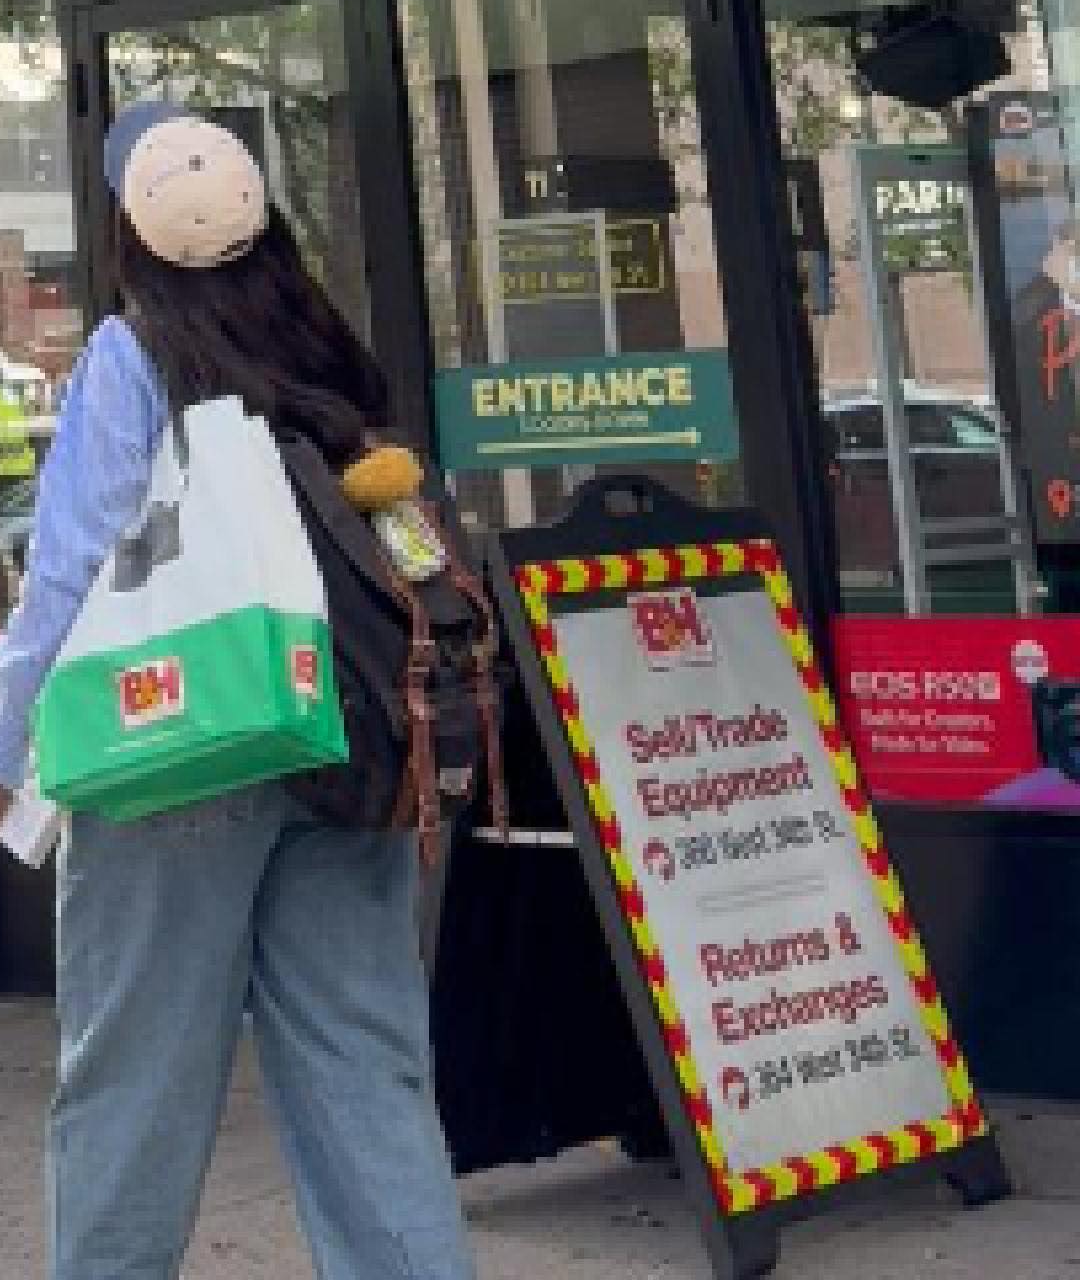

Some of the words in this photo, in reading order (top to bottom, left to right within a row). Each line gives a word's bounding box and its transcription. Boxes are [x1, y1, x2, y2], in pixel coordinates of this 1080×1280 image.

[472, 364, 693, 417] ENTRANCE
[626, 704, 788, 764] Sell/Trade
[637, 752, 813, 820] Equipment
[700, 927, 830, 987] Returns
[834, 911, 862, 956] &
[712, 974, 889, 1044] Exchanges
